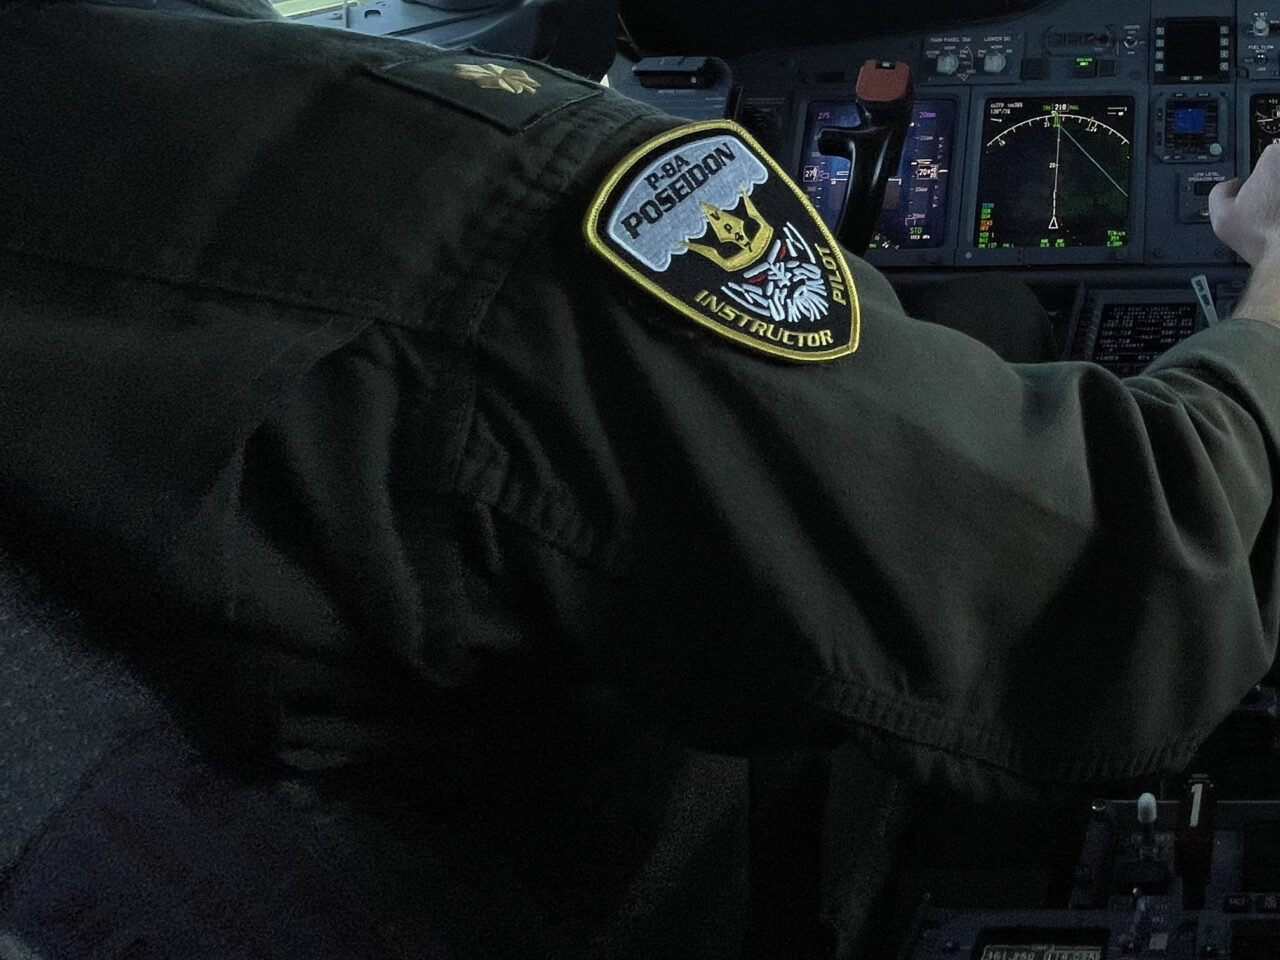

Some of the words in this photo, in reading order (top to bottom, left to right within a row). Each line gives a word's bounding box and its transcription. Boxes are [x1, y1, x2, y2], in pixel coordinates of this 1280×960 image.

[620, 142, 737, 240] POSEIDON
[645, 155, 690, 191] P-8A
[814, 243, 847, 306] PILOT
[694, 290, 834, 348] INSTRUCTOR
[1189, 784, 1204, 827] 1
